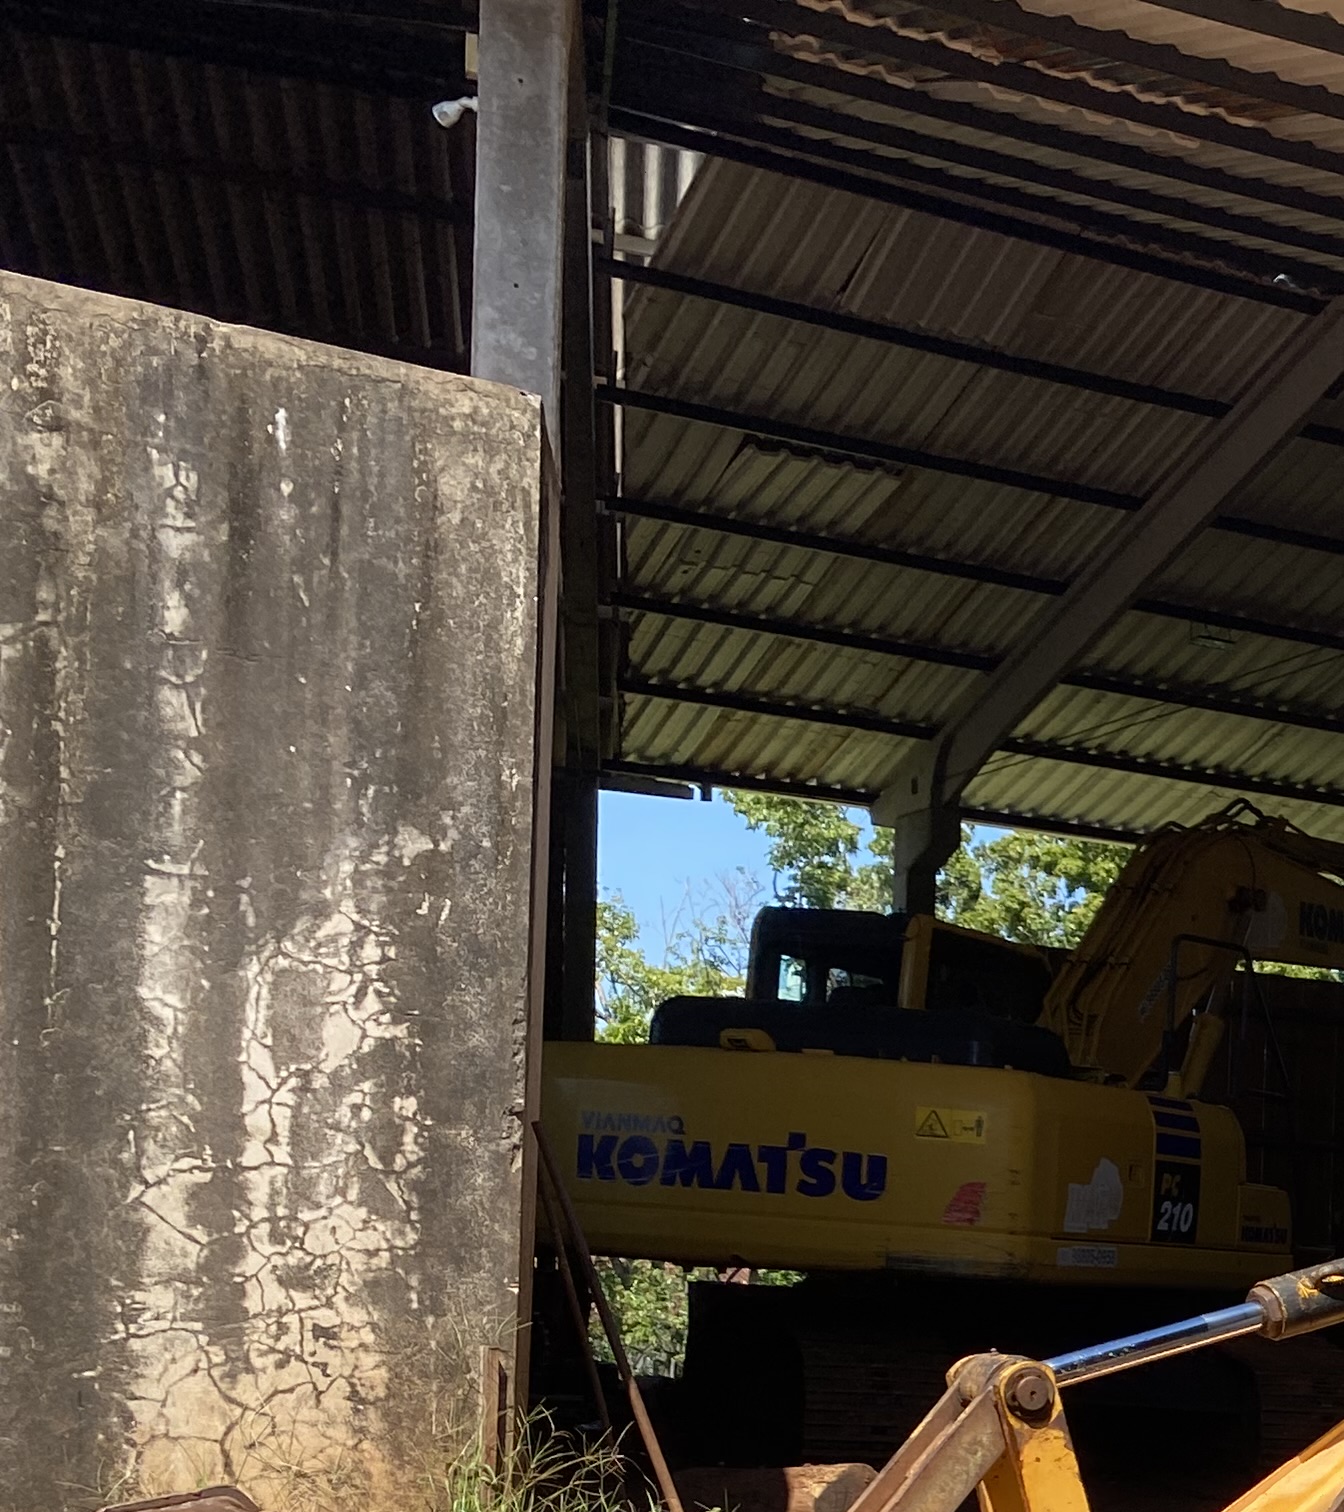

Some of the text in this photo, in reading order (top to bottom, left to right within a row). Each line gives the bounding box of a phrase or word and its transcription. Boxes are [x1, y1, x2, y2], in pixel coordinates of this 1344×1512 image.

[576, 1131, 888, 1201] KOMATSU
[1160, 1171, 1184, 1197] PC
[1156, 1200, 1194, 1233] 210
